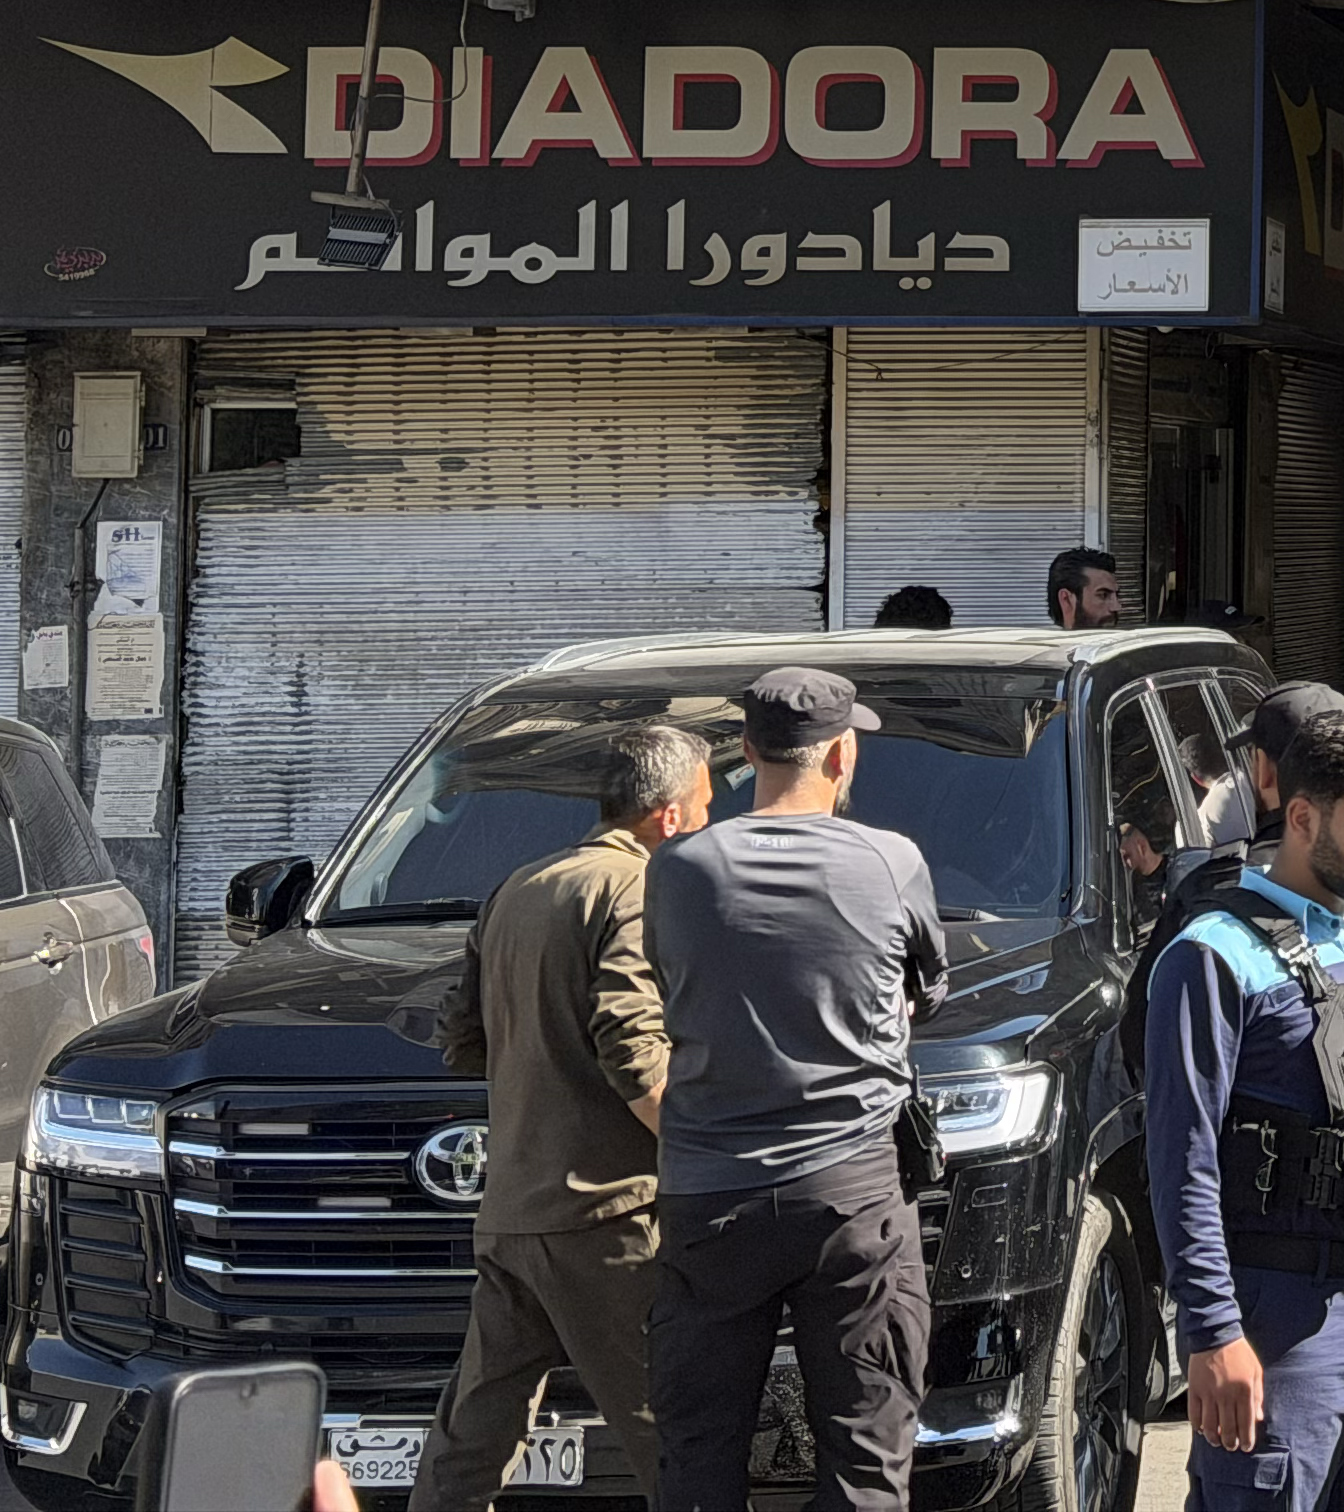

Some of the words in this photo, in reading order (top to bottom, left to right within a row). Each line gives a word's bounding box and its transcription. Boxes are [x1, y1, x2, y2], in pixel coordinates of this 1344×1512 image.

[304, 45, 1205, 168] DIADORA
[233, 198, 629, 291] الموام
[664, 198, 1011, 292] ديادورا
[1096, 228, 1192, 258] تخفيض
[1096, 267, 1189, 301] الأسعار
